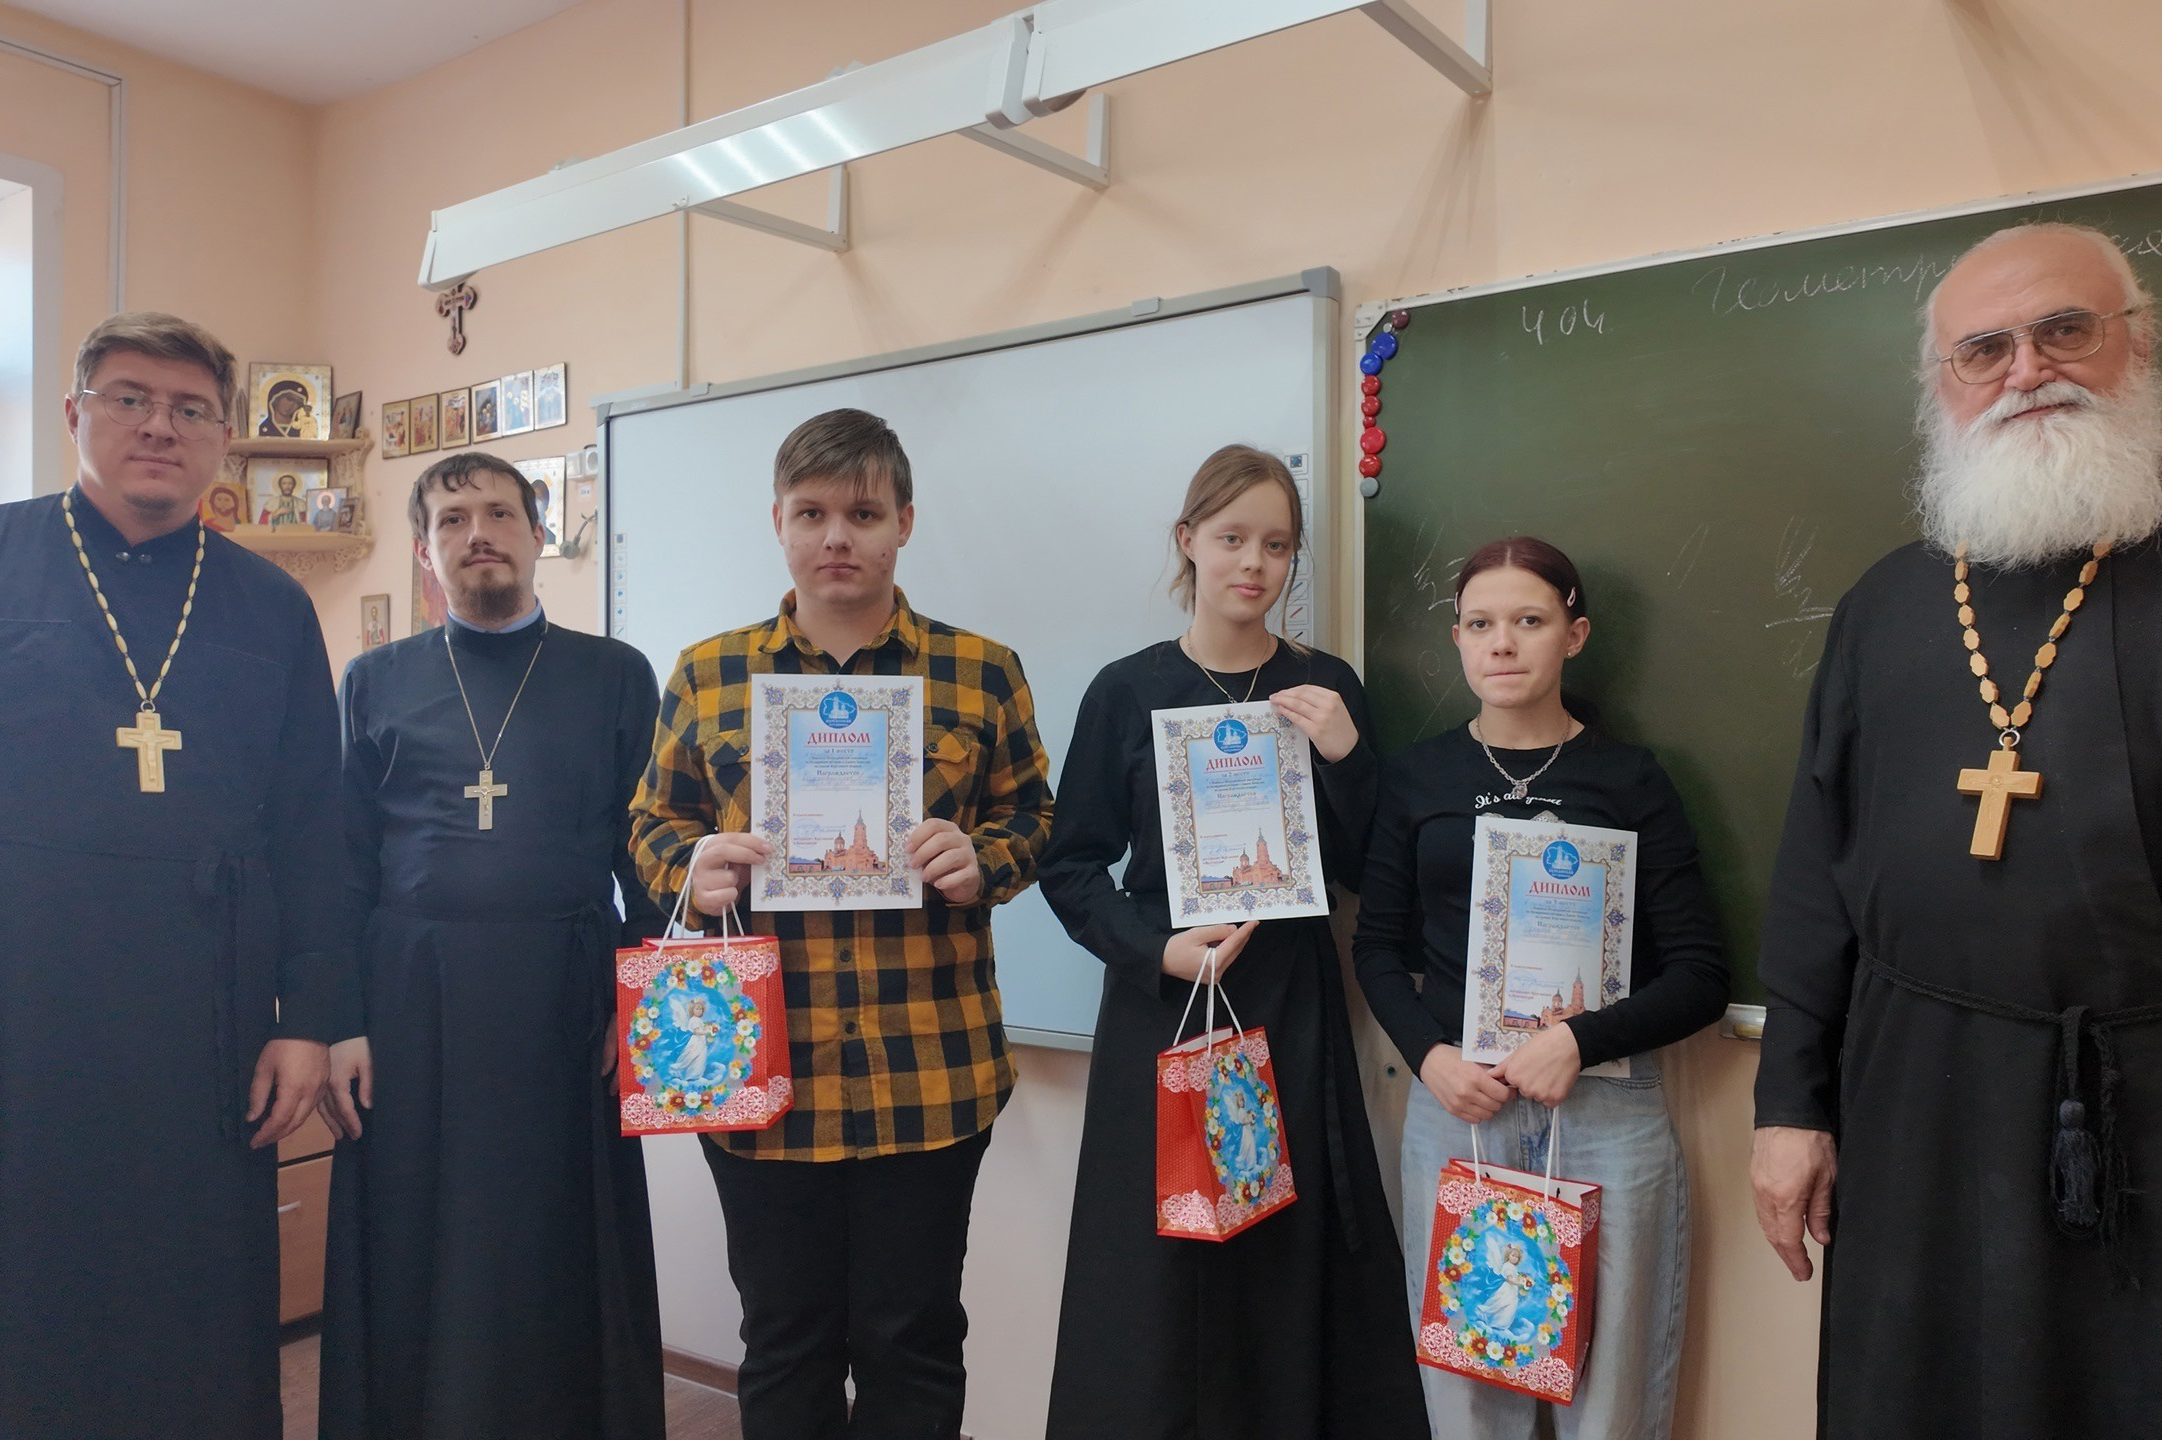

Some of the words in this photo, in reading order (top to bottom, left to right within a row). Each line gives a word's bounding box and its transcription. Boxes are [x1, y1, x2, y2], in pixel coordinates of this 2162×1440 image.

[807, 733, 870, 744] ДИПЛОМ
[1205, 755, 1264, 771] ДИПЛОМ
[1475, 792, 1501, 809] It's
[1529, 881, 1591, 897] ДИПЛОМ
